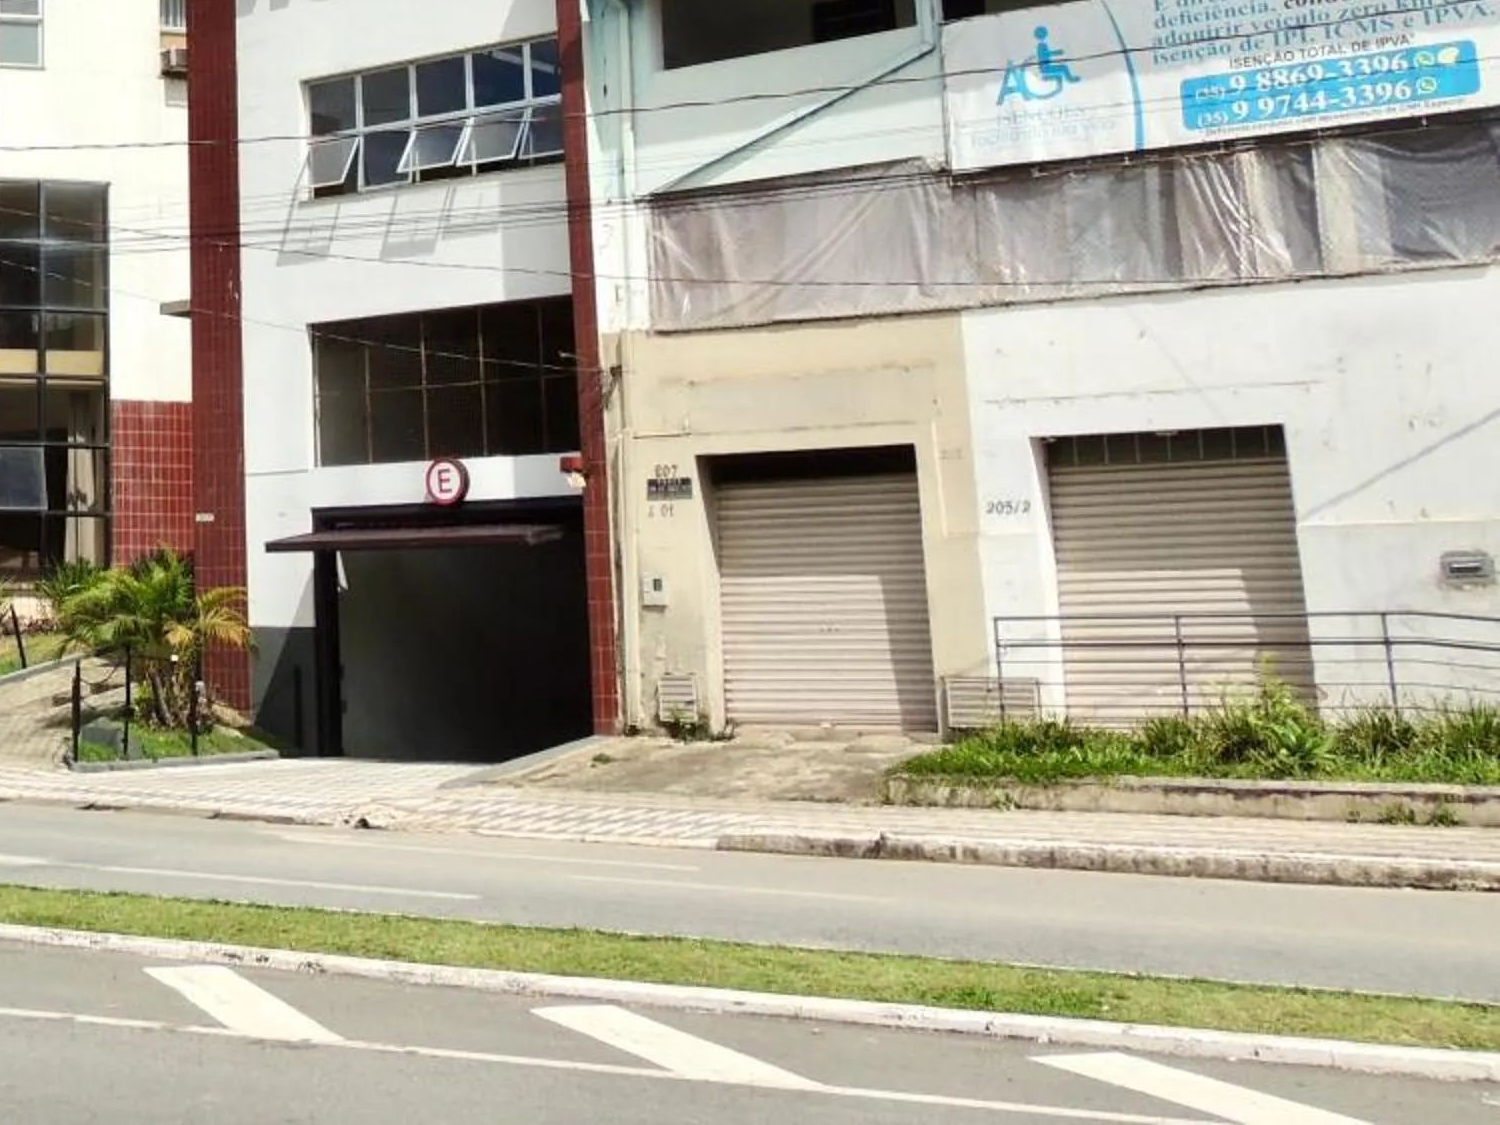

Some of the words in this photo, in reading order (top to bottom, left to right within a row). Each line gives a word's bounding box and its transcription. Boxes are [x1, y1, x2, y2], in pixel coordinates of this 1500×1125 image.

[1152, 24, 1241, 50] adquirir
[1251, 7, 1330, 32] veículo
[1338, 1, 1388, 21] zero
[1152, 39, 1232, 65] isenção
[1239, 35, 1265, 52] de
[1323, 17, 1396, 40] ICMS
[1403, 15, 1414, 28] e
[1229, 48, 1295, 70] ISENÇÃO
[1301, 43, 1346, 62] TOTAL
[1352, 39, 1372, 54] DE
[1229, 74, 1246, 92] 9
[1257, 52, 1409, 92] 8869-3396
[1231, 100, 1249, 120] 9
[1258, 79, 1412, 116] 9744-3396
[438, 468, 453, 493] E
